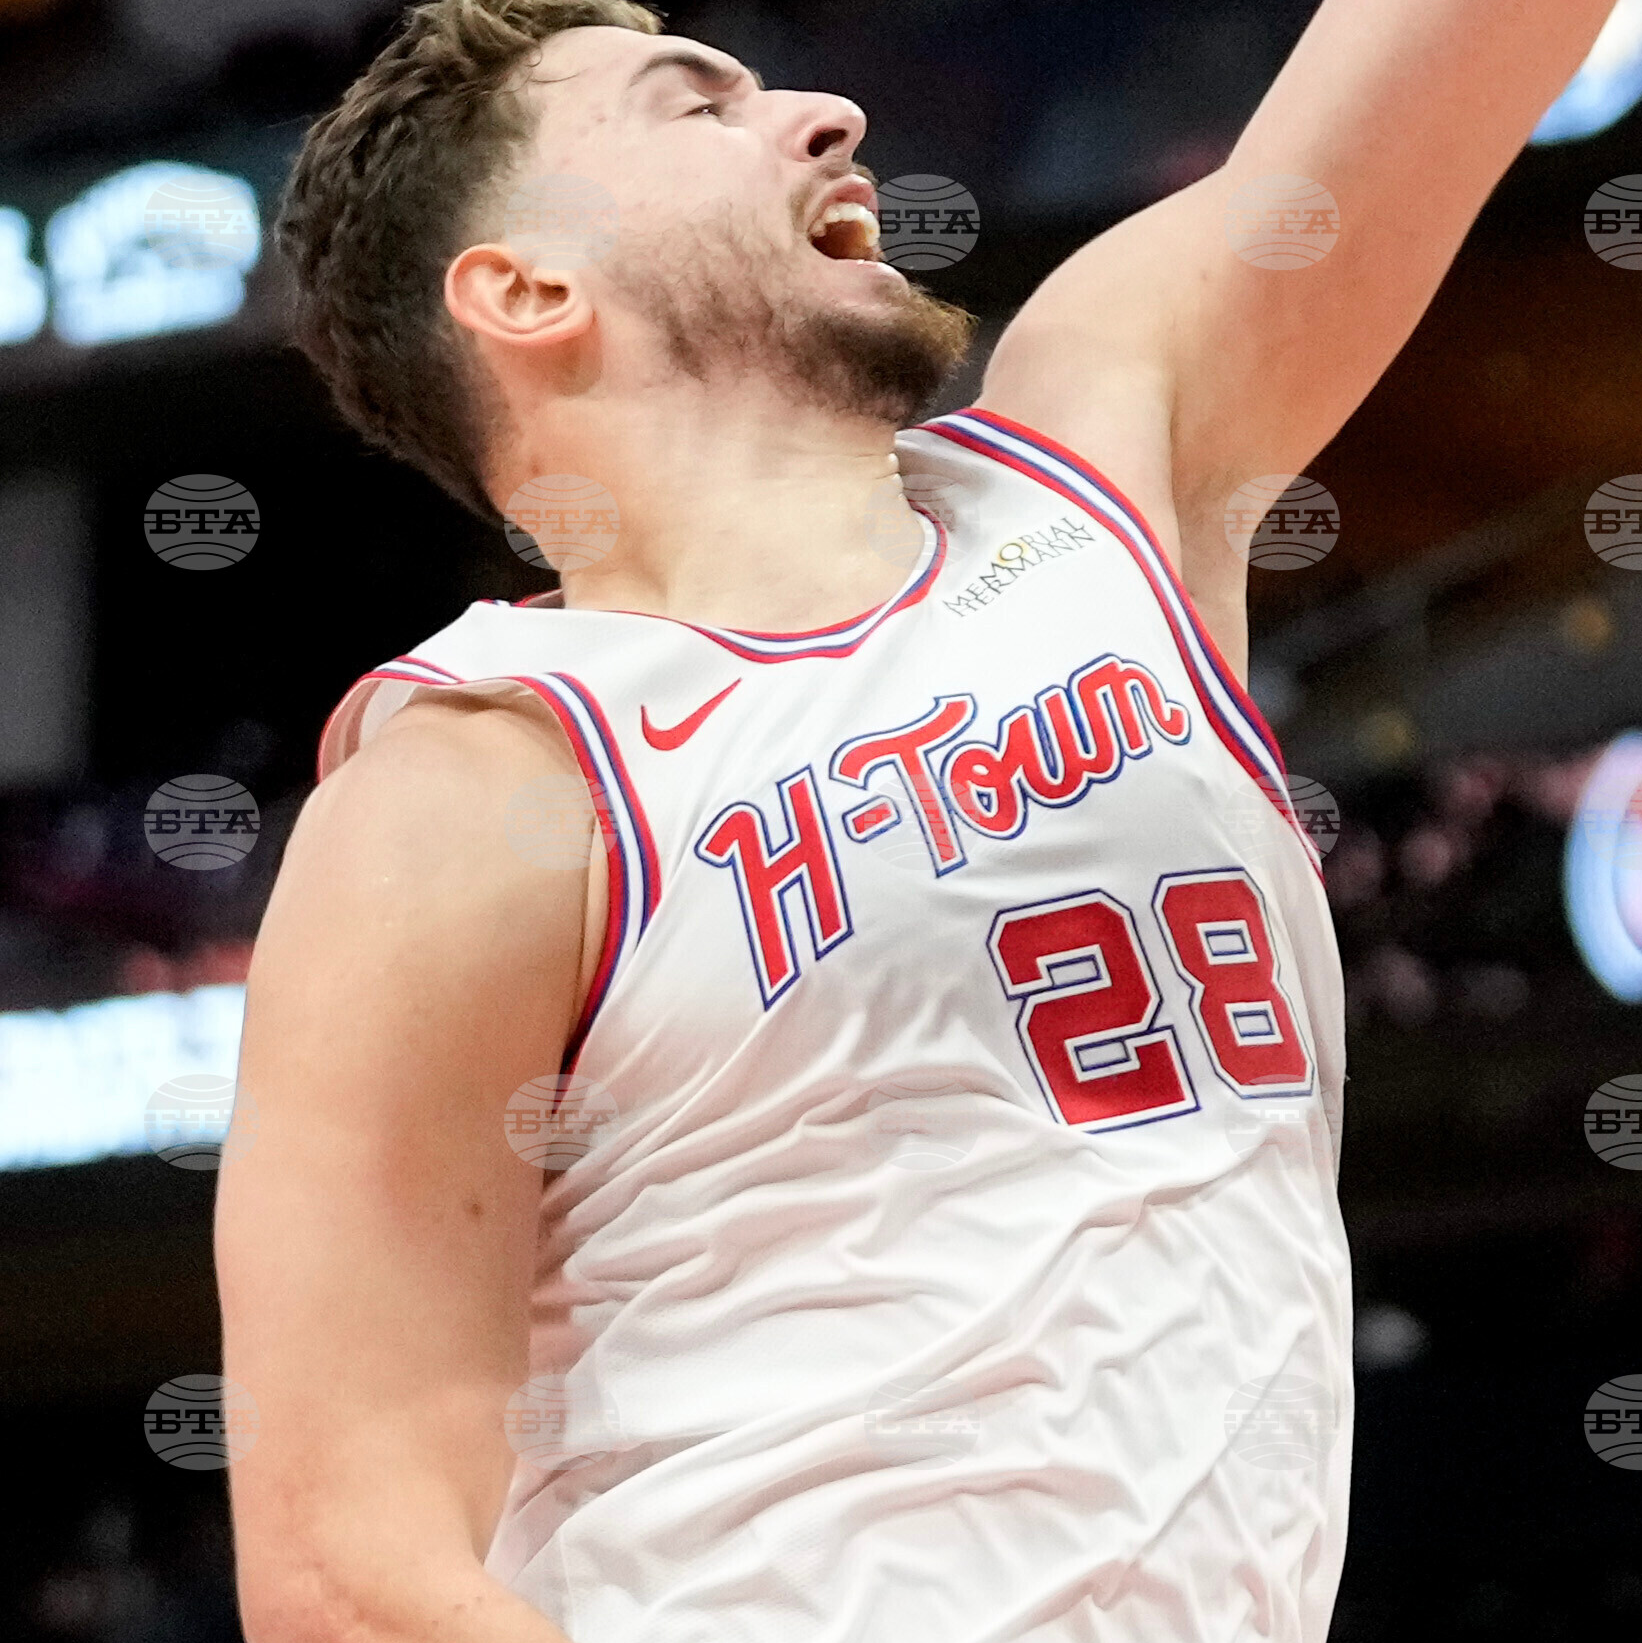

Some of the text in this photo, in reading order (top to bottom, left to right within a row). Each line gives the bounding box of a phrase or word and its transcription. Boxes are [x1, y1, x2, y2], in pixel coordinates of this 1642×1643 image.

[943, 517, 1085, 608] MEMORIAL
[951, 524, 1097, 618] HERMANN
[693, 652, 1191, 1012] H-Town
[986, 865, 1316, 1135] 28
